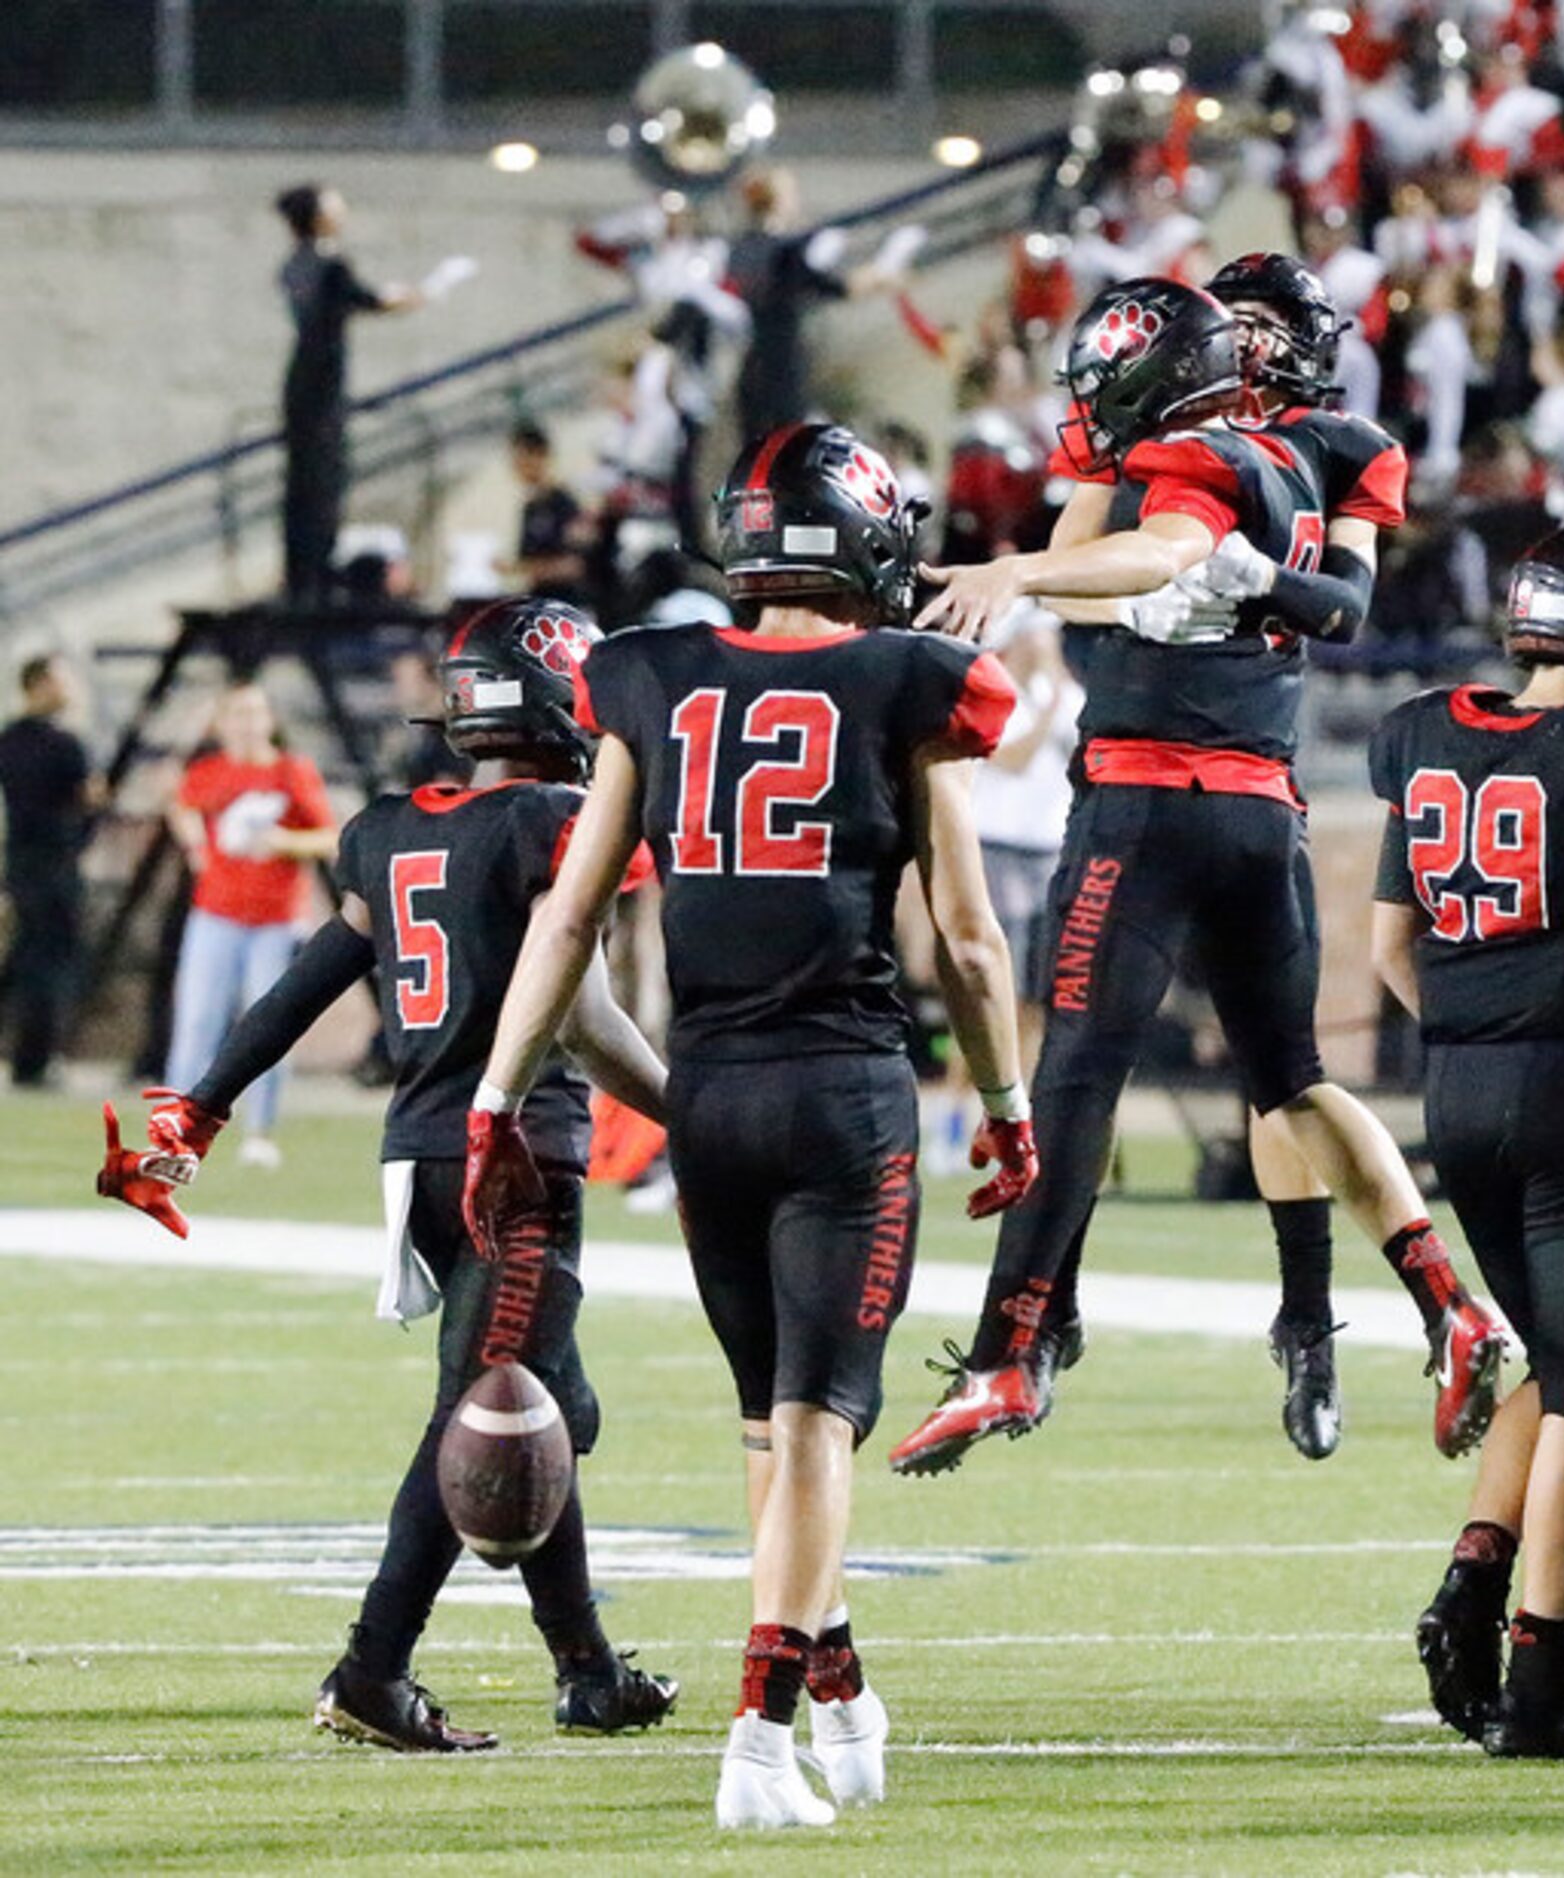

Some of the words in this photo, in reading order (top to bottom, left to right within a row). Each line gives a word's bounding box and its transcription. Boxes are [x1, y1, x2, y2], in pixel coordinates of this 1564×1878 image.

[740, 490, 774, 532] 12
[668, 687, 841, 878] 12
[1404, 767, 1550, 944] 29
[389, 849, 450, 1031] 5
[1052, 856, 1124, 1013] PANTHERS
